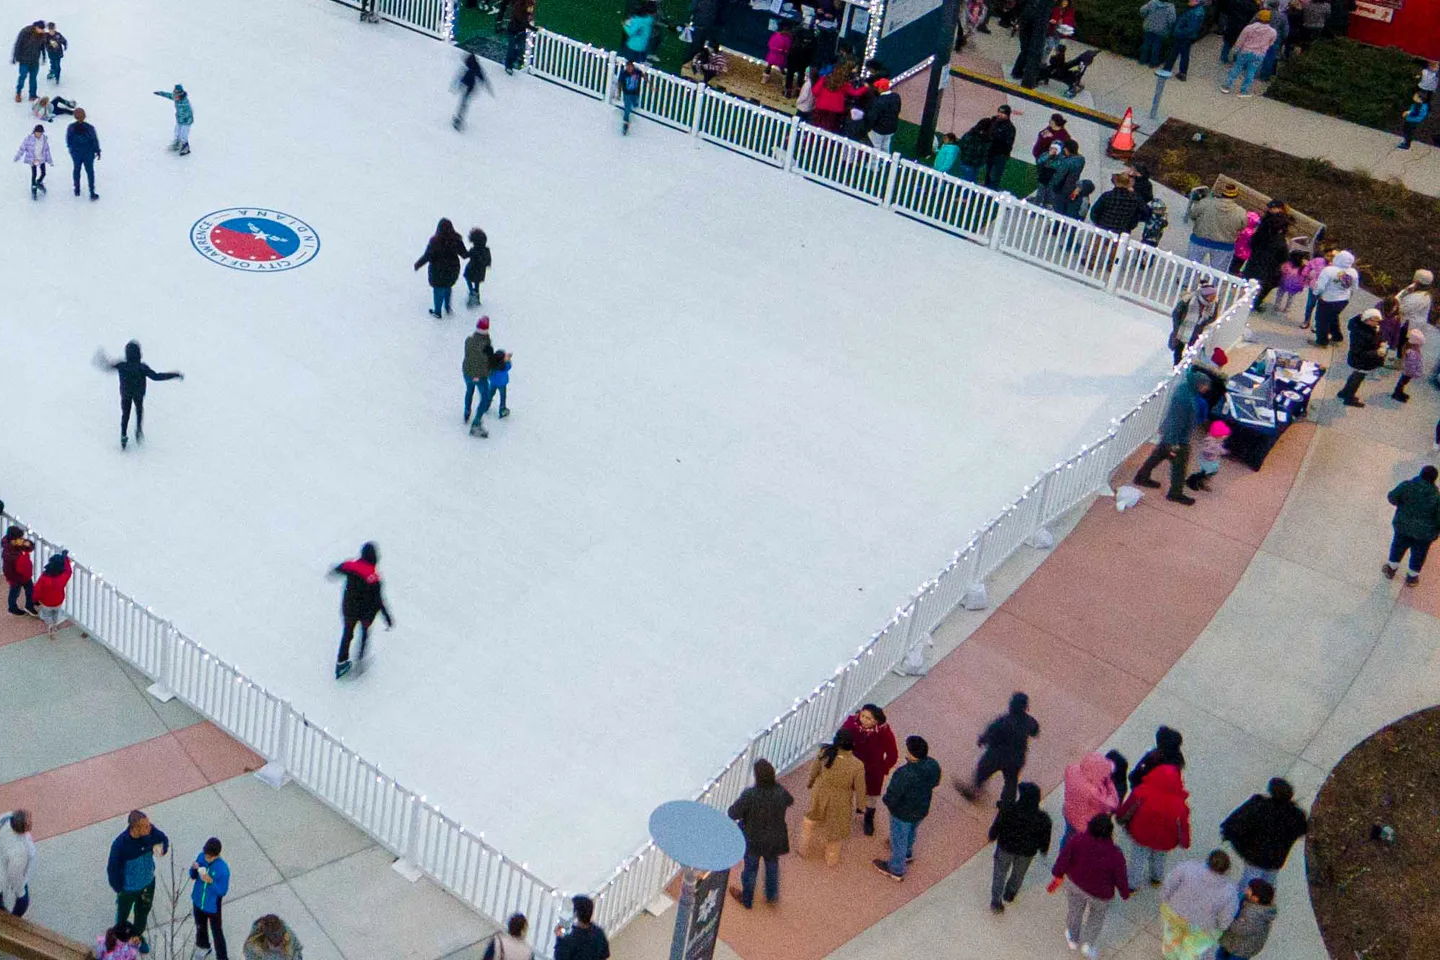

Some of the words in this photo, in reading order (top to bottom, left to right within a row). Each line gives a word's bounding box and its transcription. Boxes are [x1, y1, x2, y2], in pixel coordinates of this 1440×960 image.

[195, 220, 229, 262] LAWRENCE
[238, 210, 315, 249] INDIANA
[230, 260, 251, 269] OF
[257, 261, 292, 270] CITY
